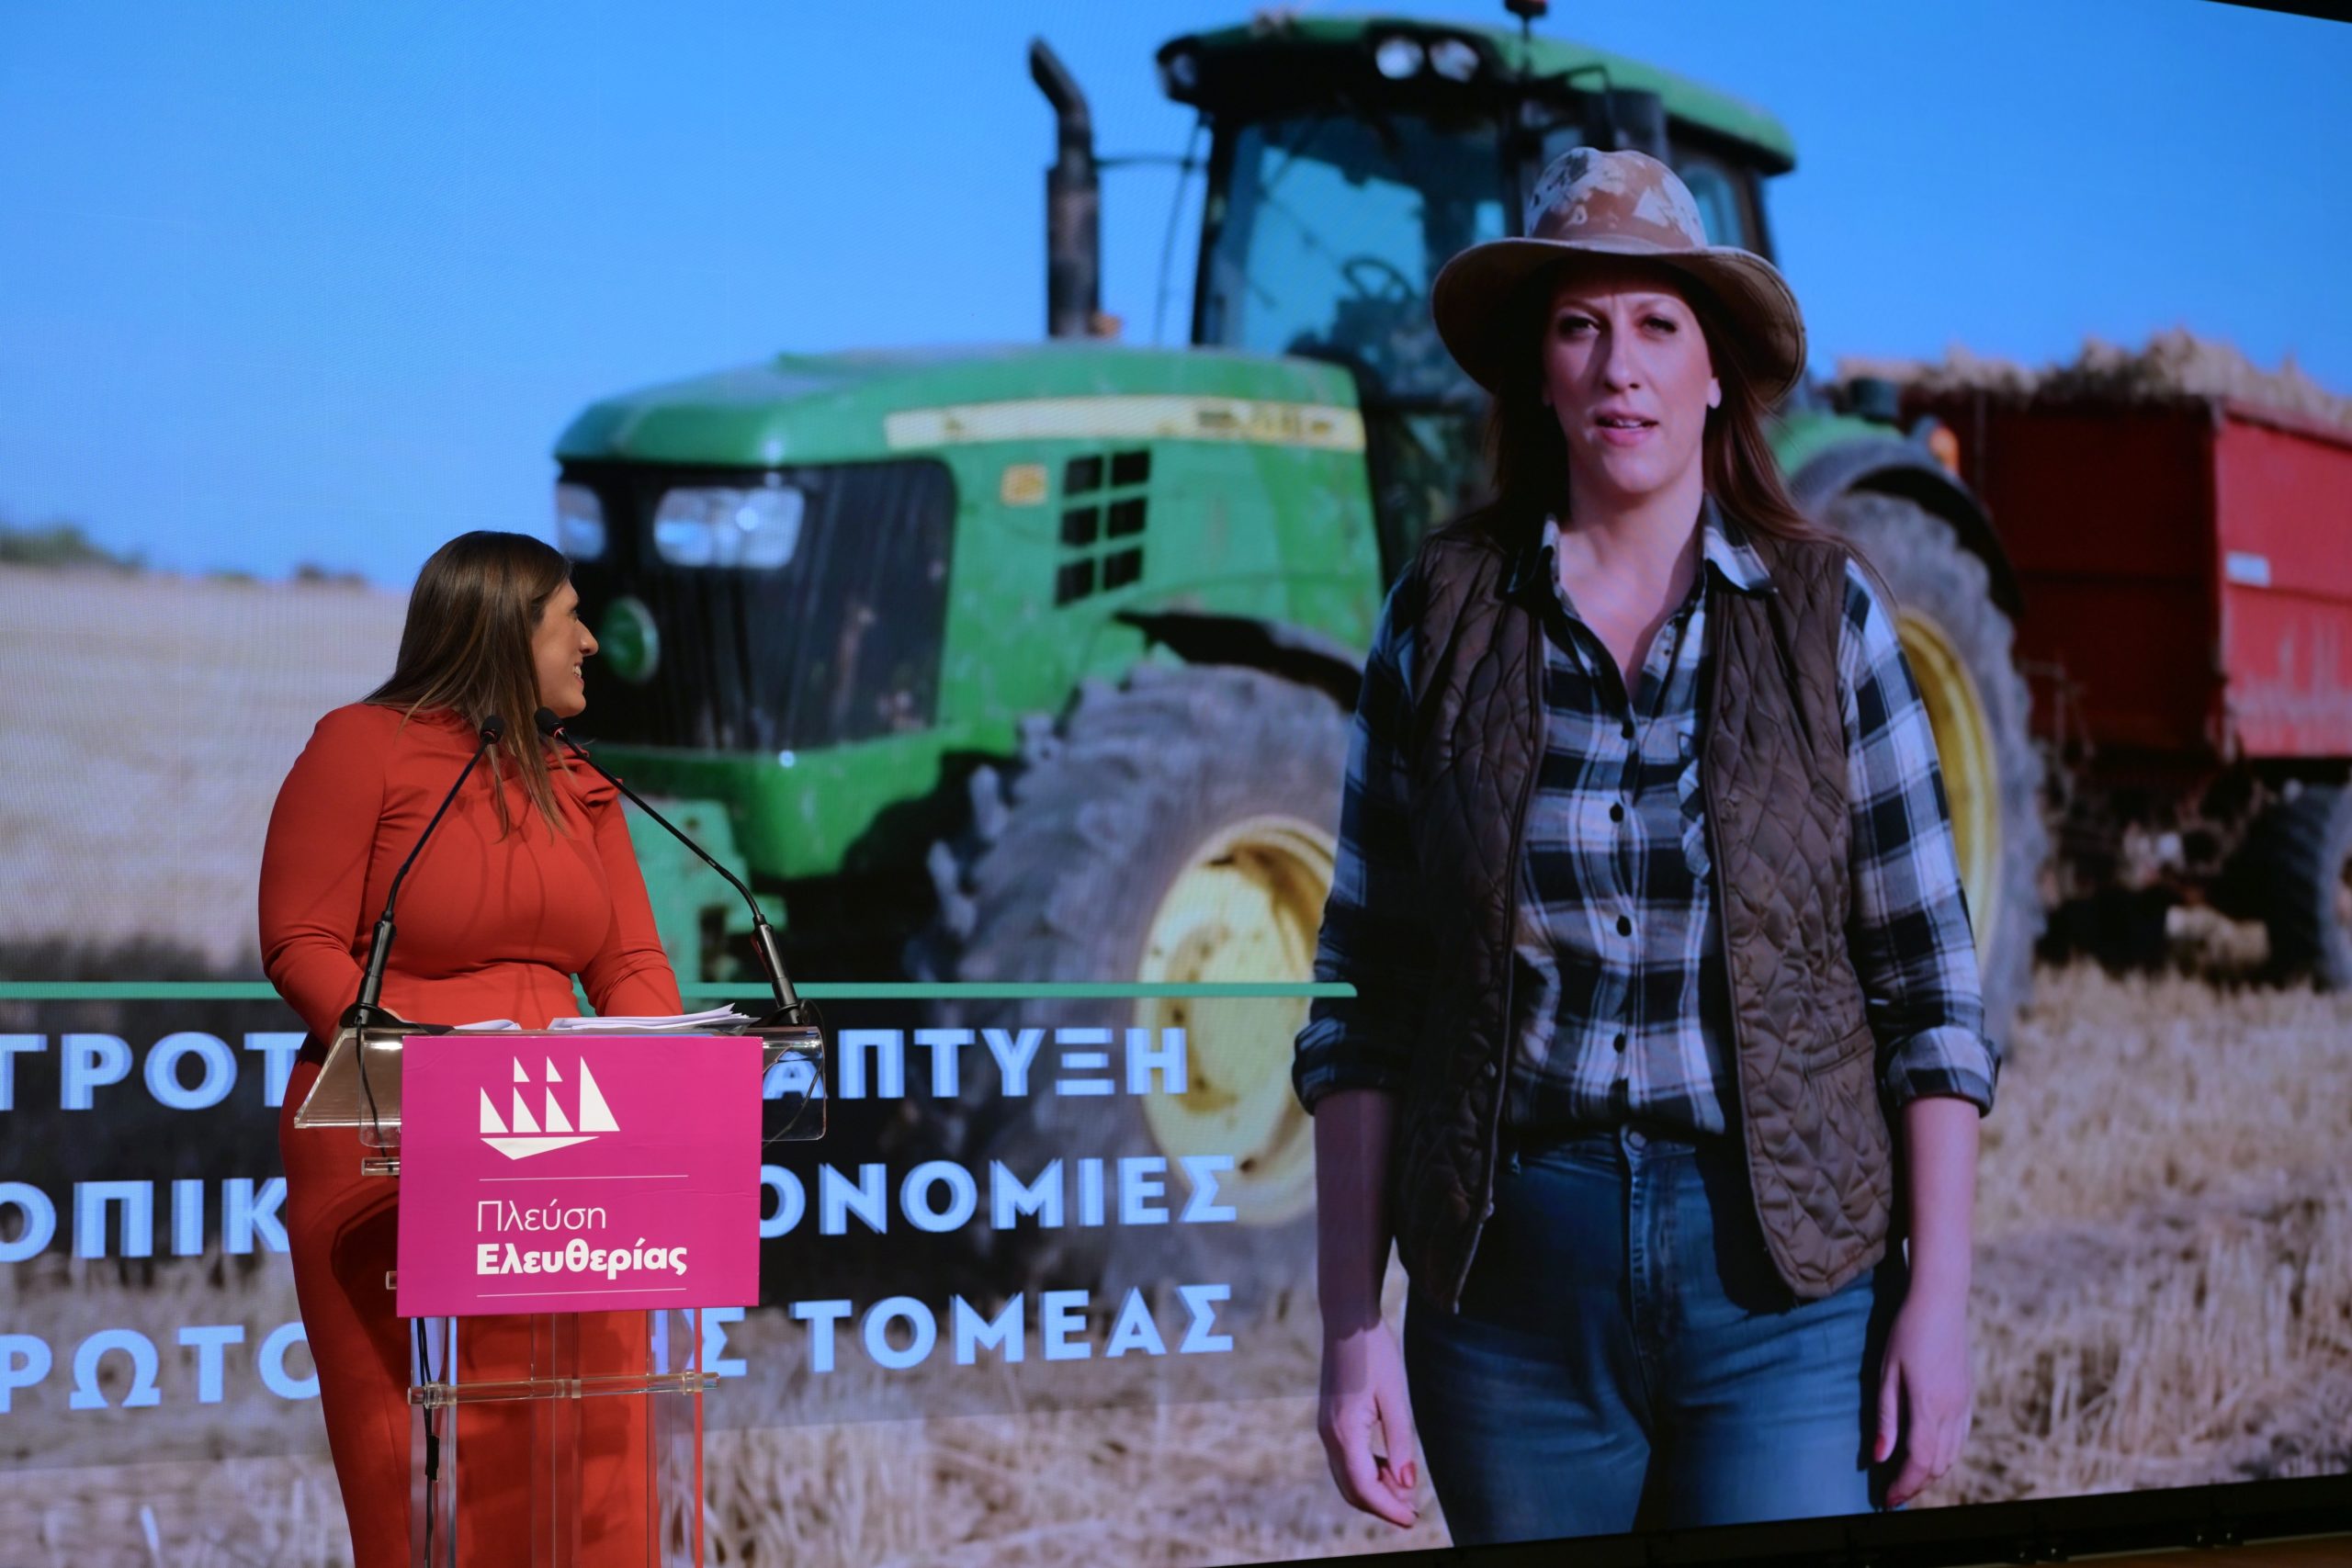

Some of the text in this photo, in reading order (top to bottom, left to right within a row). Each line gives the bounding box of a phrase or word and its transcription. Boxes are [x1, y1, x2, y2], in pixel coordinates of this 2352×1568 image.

[477, 1199, 606, 1232] Πλεύση
[760, 1155, 1238, 1238] ΟΝΟΜΙΕΣ
[476, 1237, 687, 1280] Ελευθερίας
[789, 1283, 1233, 1373] ΤΟΜΕΑΣ
